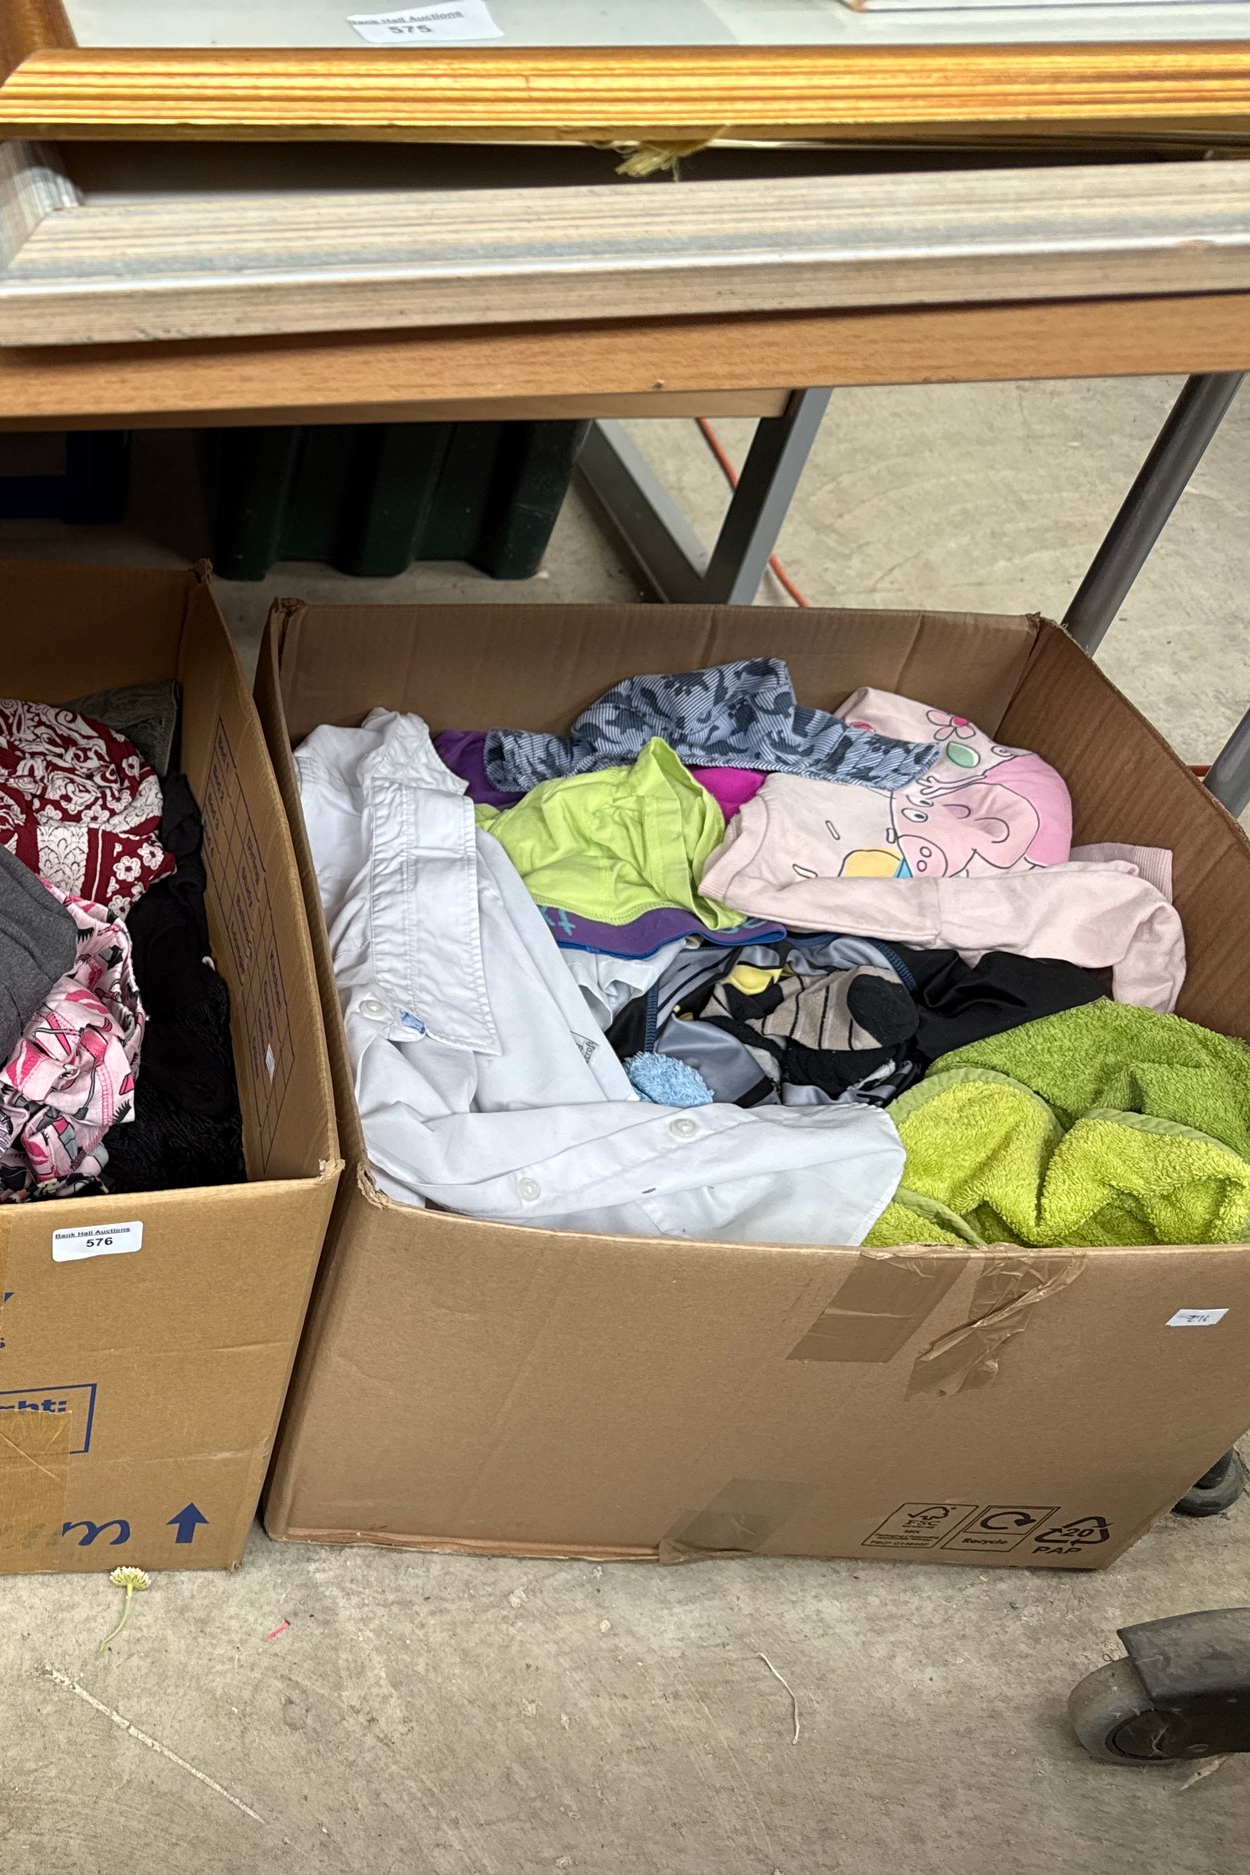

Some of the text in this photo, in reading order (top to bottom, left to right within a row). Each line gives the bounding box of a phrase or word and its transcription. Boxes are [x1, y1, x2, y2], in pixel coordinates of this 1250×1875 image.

[409, 11, 462, 22] Auctions
[388, 24, 432, 34] 575
[78, 1229, 93, 1237] Hall
[95, 1227, 130, 1235] Auctions
[86, 1237, 113, 1247] 576
[1061, 1527, 1095, 1538] 20
[961, 1537, 1009, 1546] Recycle
[1031, 1546, 1084, 1555] PAP
